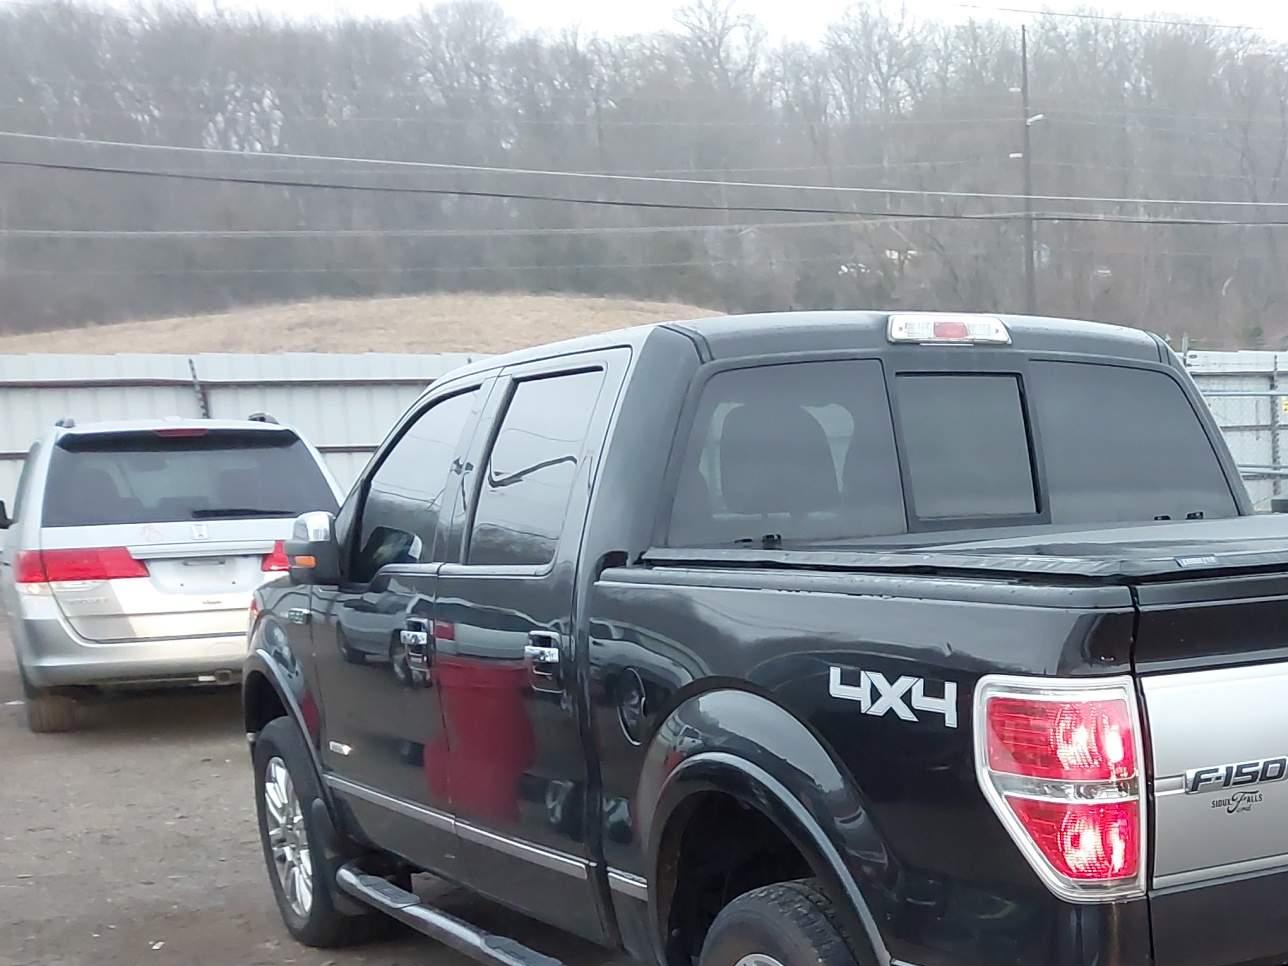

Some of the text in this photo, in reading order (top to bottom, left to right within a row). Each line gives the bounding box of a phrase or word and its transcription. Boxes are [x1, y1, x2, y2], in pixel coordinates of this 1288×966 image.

[829, 666, 957, 728] 4X4
[1191, 758, 1287, 792] F-150
[1211, 798, 1233, 809] SIOUX
